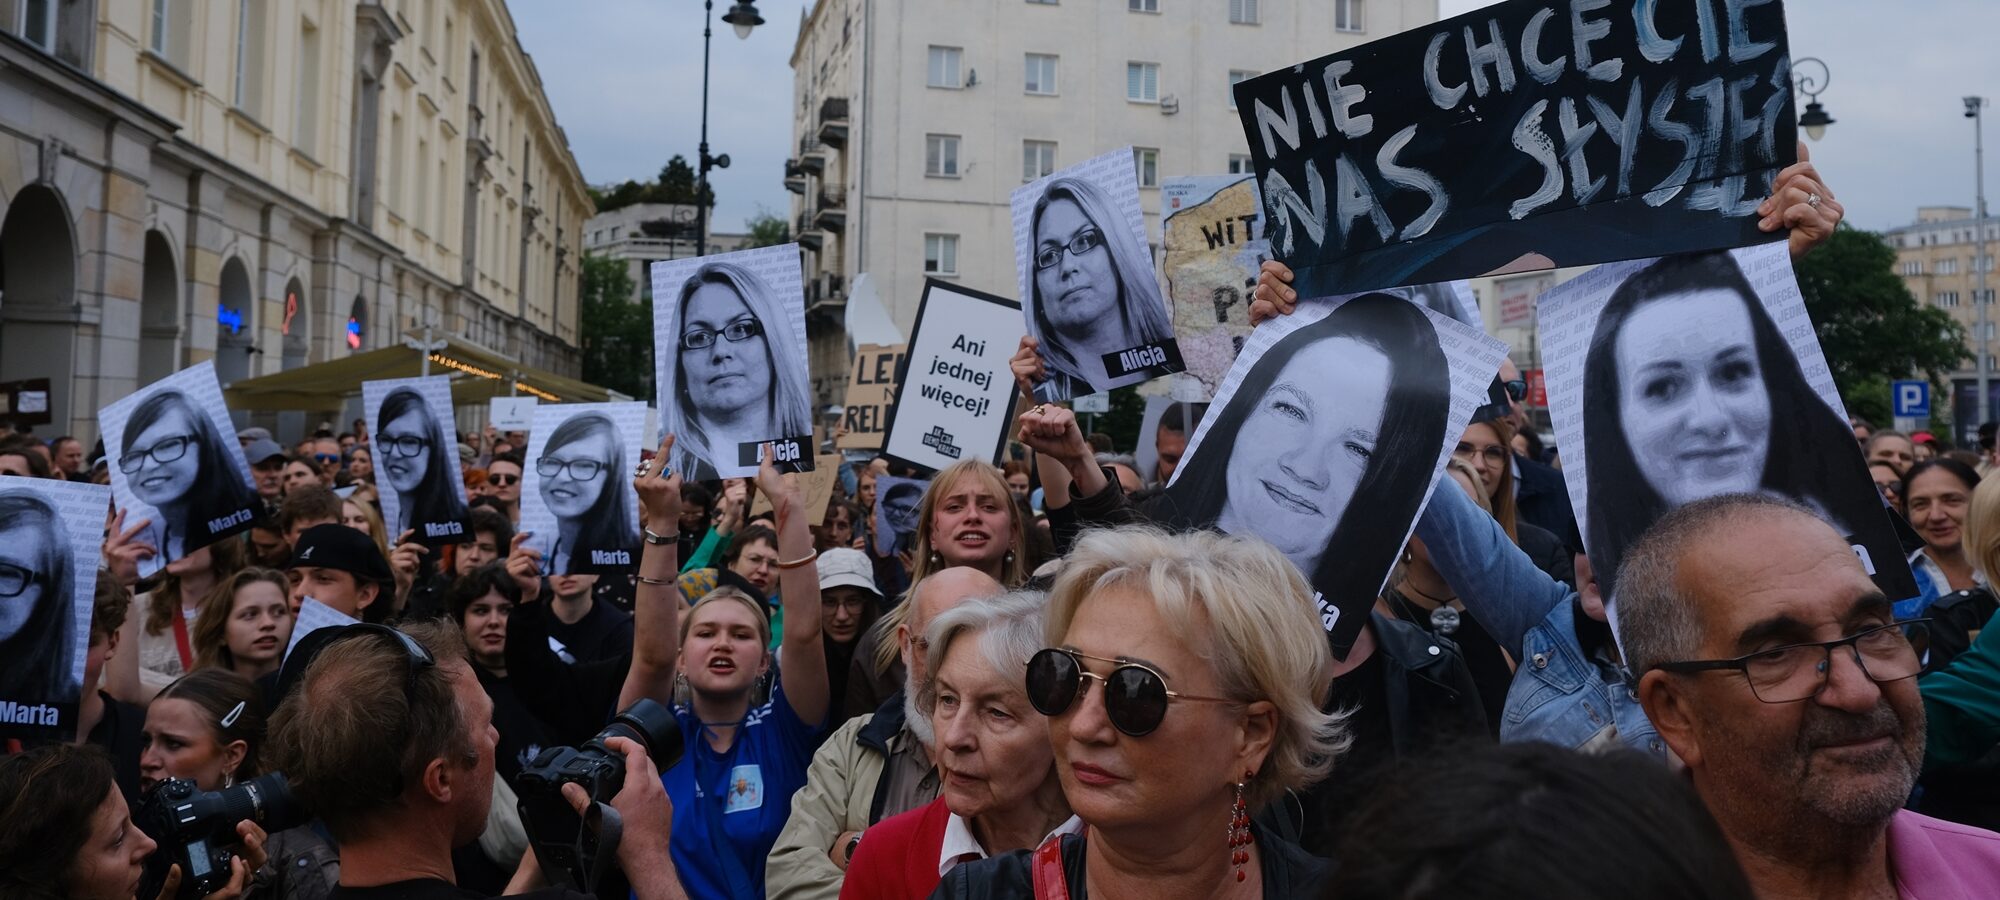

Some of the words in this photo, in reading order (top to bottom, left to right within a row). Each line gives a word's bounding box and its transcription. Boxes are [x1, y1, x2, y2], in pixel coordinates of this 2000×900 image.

[1255, 60, 1373, 159] NIE
[1265, 124, 1449, 258] NAS
[1766, 268, 1793, 285] JEDN
[1778, 303, 1807, 323] JEDN
[952, 334, 986, 358] Ani
[1120, 345, 1167, 371] Alicja
[929, 355, 993, 392] jednej
[921, 384, 990, 418] więcej!
[1900, 384, 1922, 415] P
[757, 440, 800, 463] Aicja
[208, 507, 252, 534] Marta
[425, 520, 463, 537] Marta
[591, 549, 631, 565] Marta
[0, 701, 58, 726] Marta
